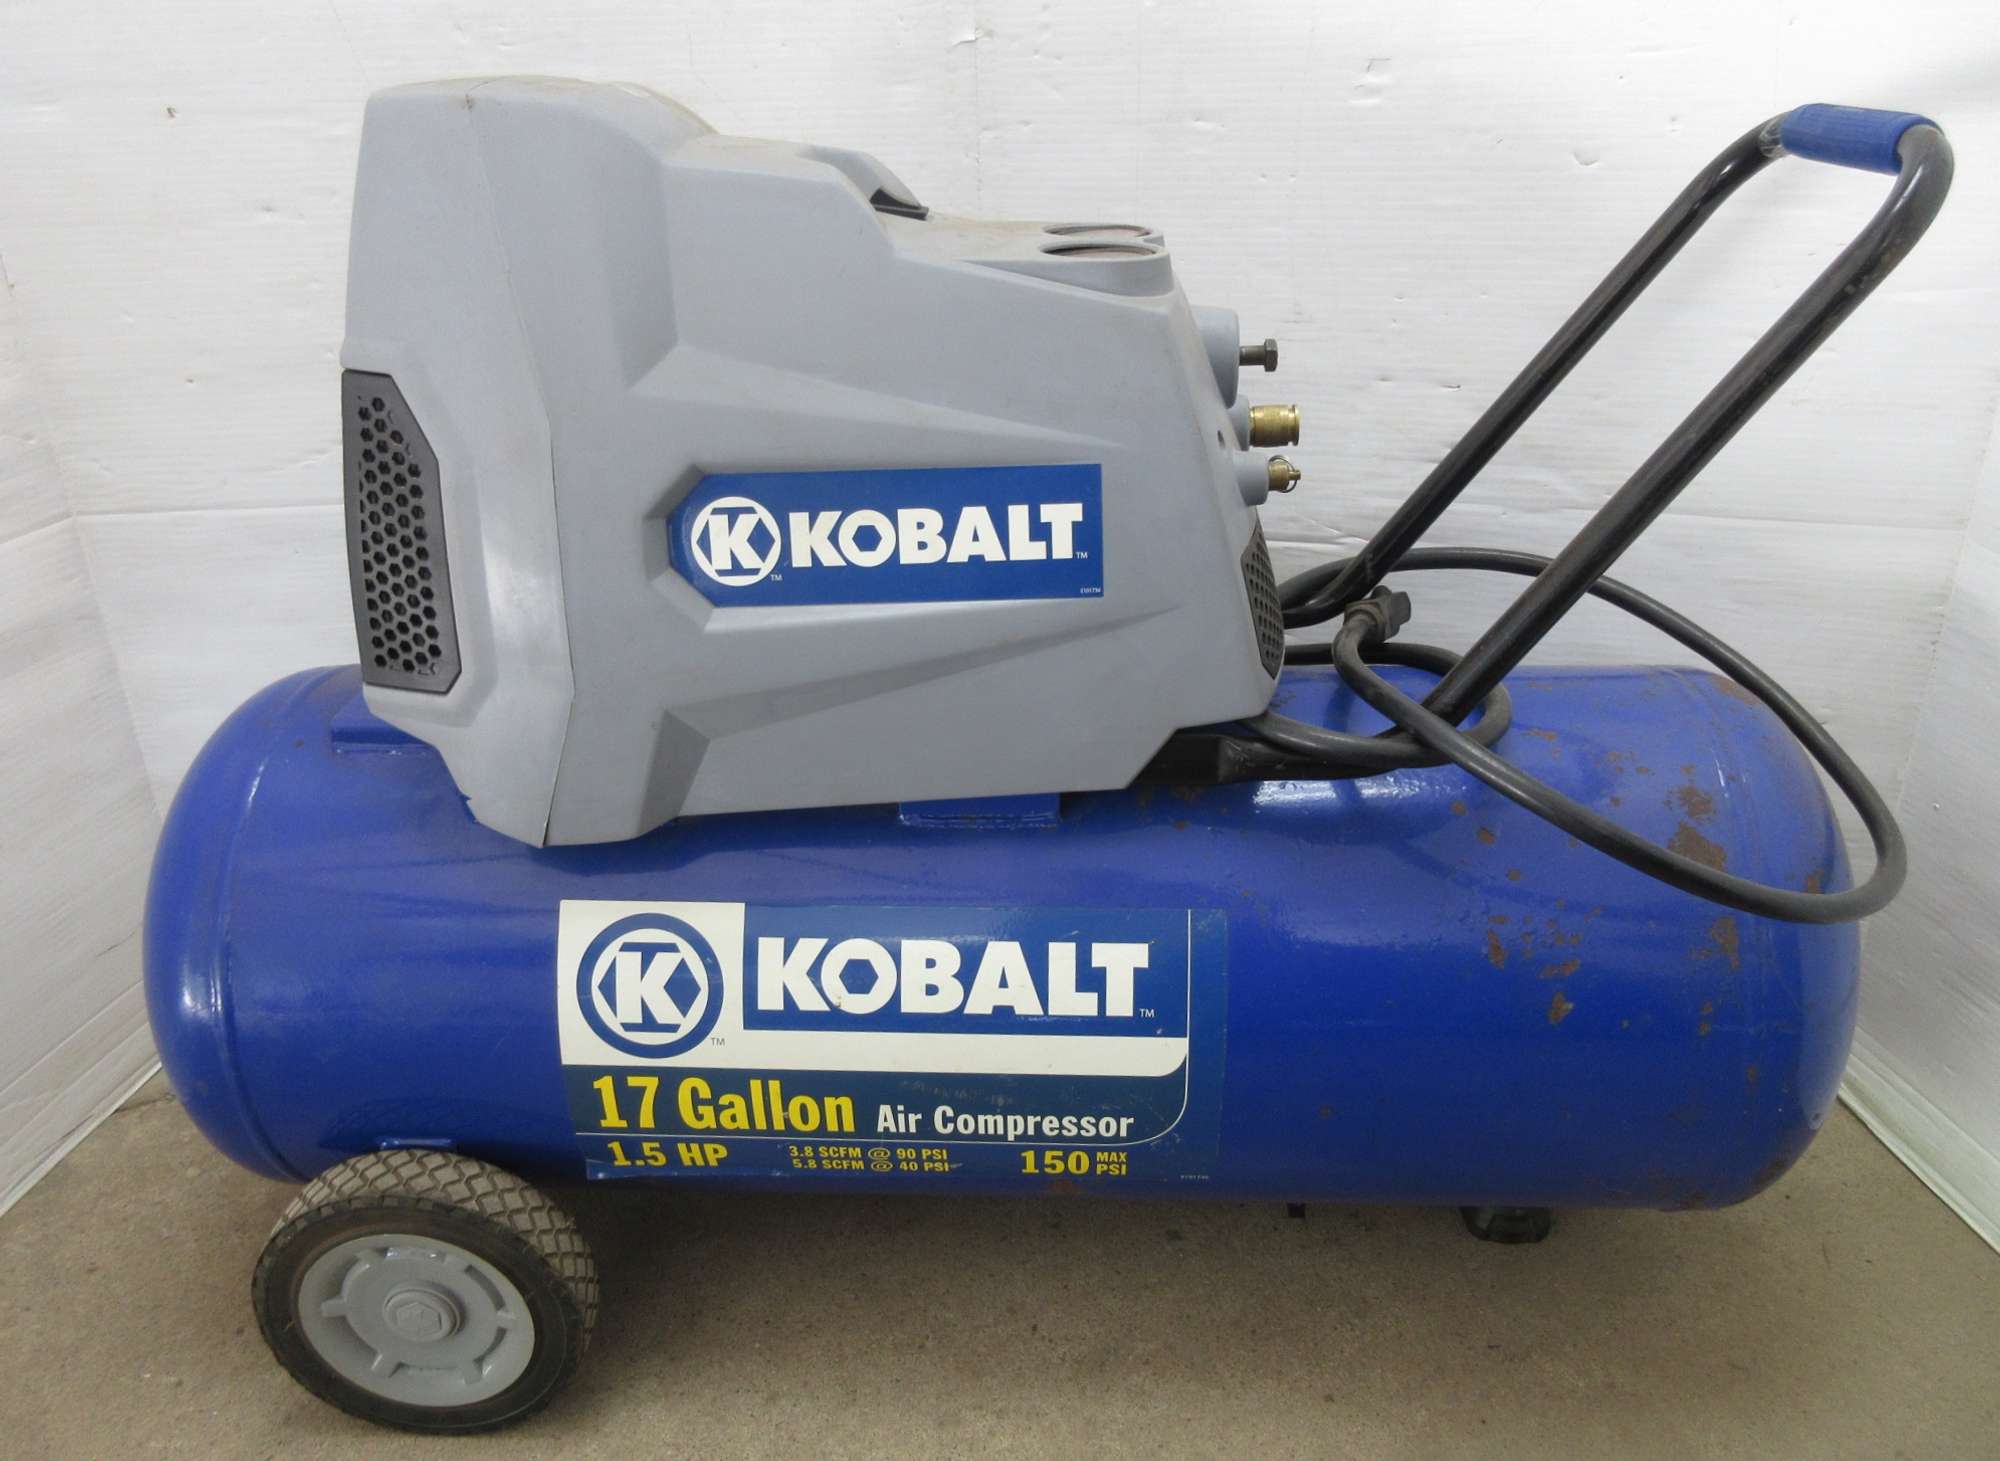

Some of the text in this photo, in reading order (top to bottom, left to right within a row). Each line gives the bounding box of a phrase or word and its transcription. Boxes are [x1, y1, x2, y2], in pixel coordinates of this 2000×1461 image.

[788, 502, 1084, 568] KOBALT
[757, 936, 1149, 1017] KOBALT
[592, 1074, 1135, 1142] 17 Gallon Air Compressor
[606, 1140, 729, 1168] 1.5 HP
[788, 1145, 948, 1161] 3.8 SCFM @ 90 PSI
[792, 1158, 950, 1173] 5.8 SCFM @ 40 PSI
[1019, 1149, 1090, 1175] 150
[1096, 1151, 1128, 1163] MAX
[1095, 1163, 1128, 1176] PSI
